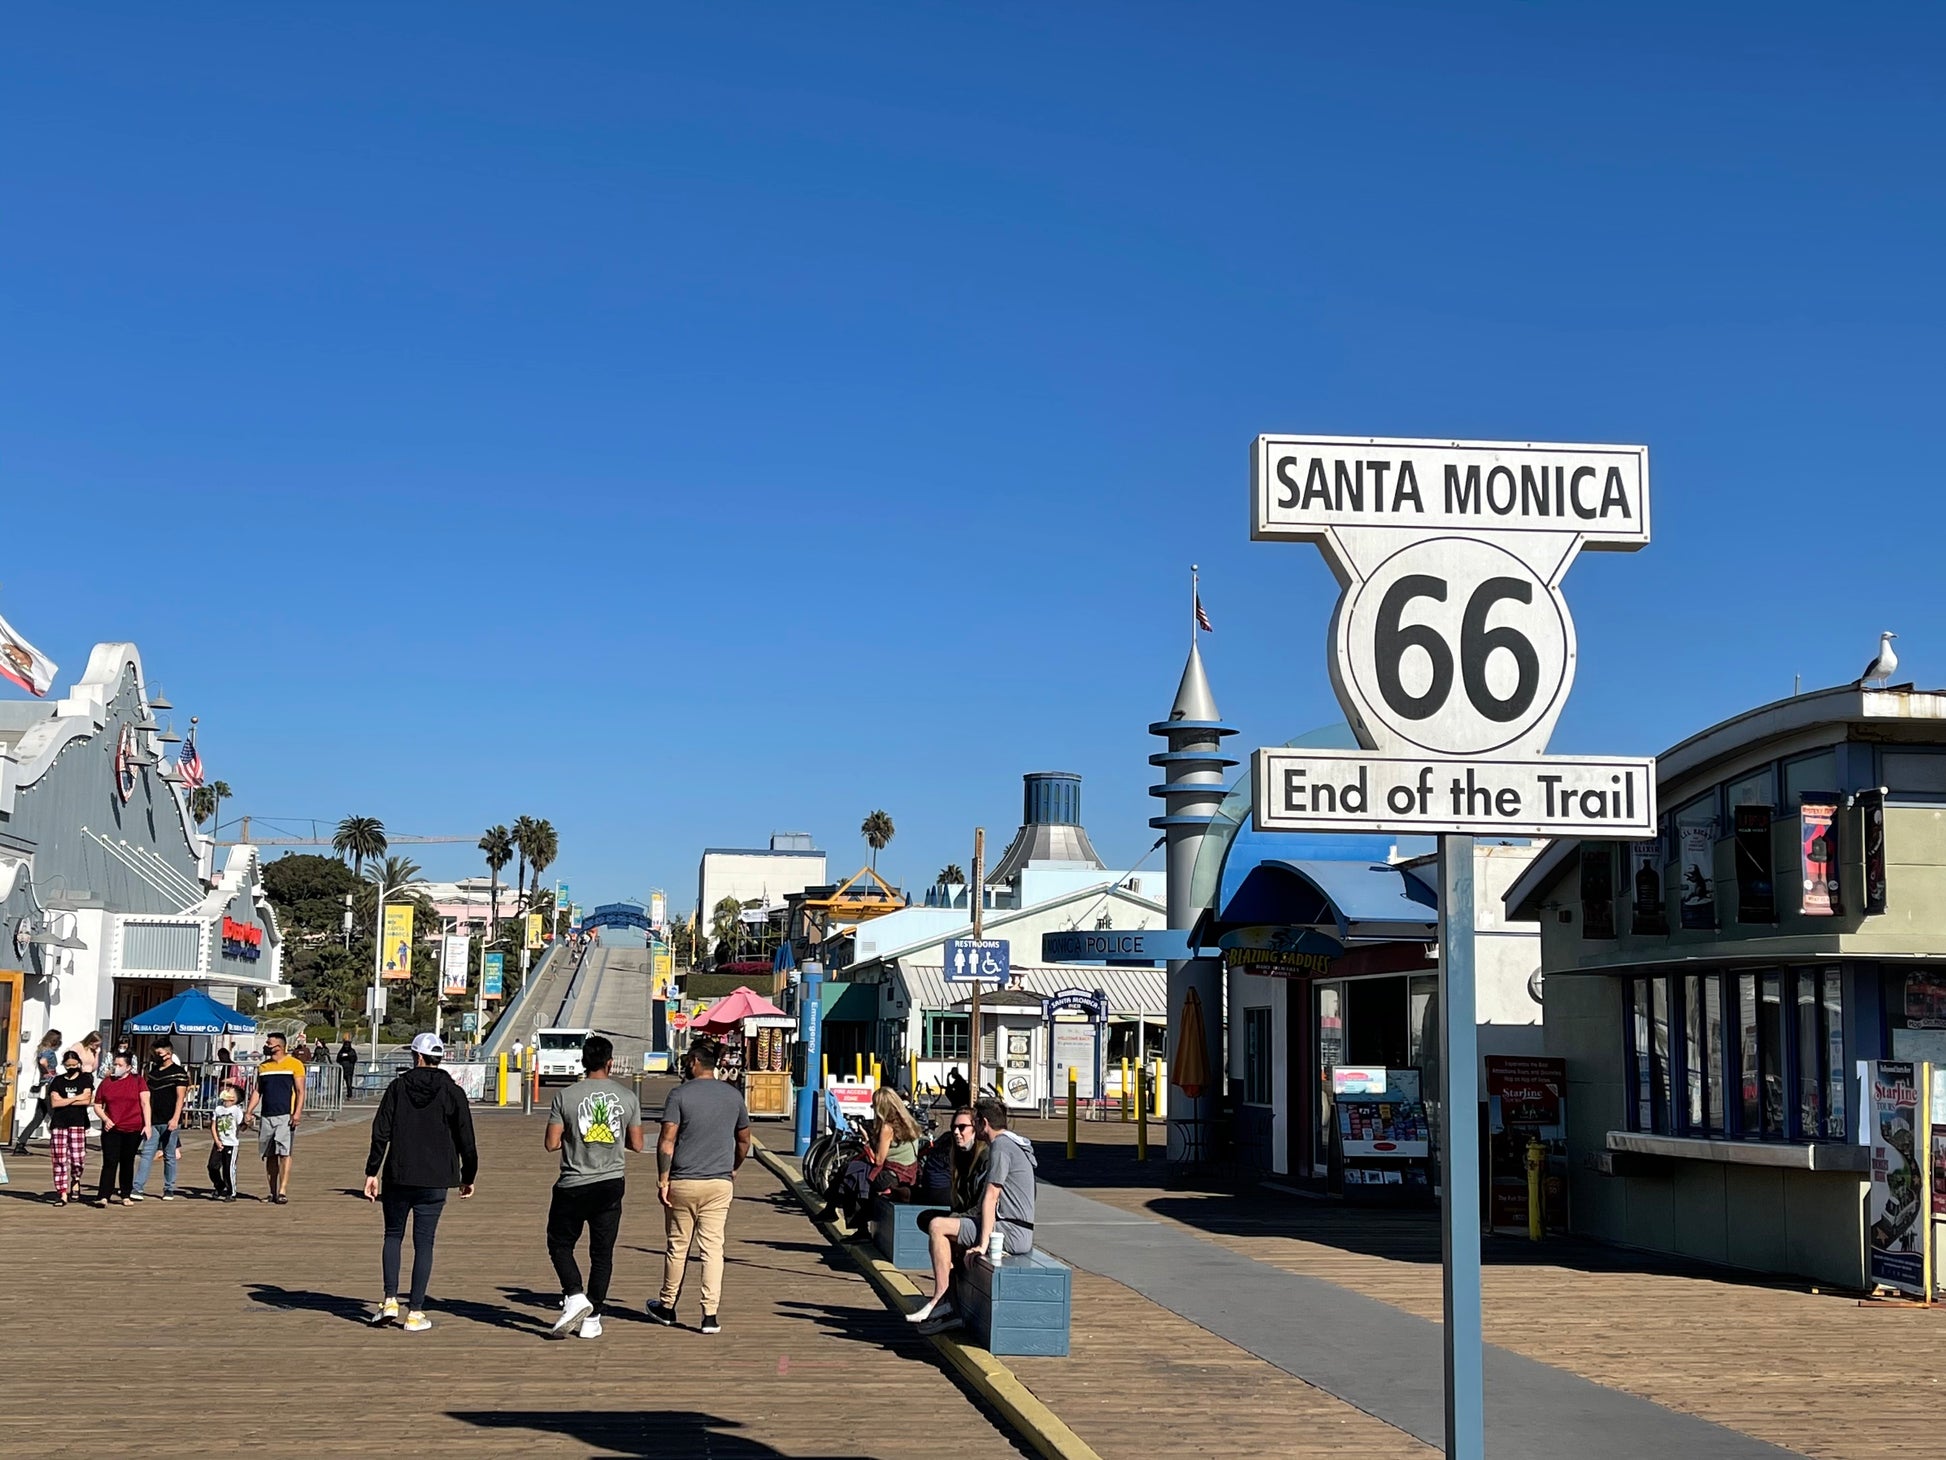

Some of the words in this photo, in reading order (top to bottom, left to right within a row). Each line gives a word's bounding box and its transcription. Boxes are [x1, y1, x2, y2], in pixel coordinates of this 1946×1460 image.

[1276, 456, 1424, 513] SANTA
[1445, 464, 1632, 520] MONICA
[1374, 574, 1539, 722] 66
[1284, 766, 1368, 813] End
[1387, 767, 1434, 815] of
[1450, 768, 1521, 818] the
[1538, 771, 1635, 819] Trail
[1099, 918, 1112, 930] THE
[955, 940, 1000, 949] RESTROOMS
[1086, 936, 1144, 953] POLICE
[1228, 948, 1278, 968] BLAZING
[1280, 952, 1330, 975] SADDLES
[1051, 997, 1071, 1009] SANTA
[1072, 997, 1098, 1009] MONICA
[153, 1024, 170, 1032] GUMP
[180, 1024, 205, 1032] SHRIMP
[808, 1001, 819, 1054] Emergency
[1876, 1101, 1896, 1111] TOURS
